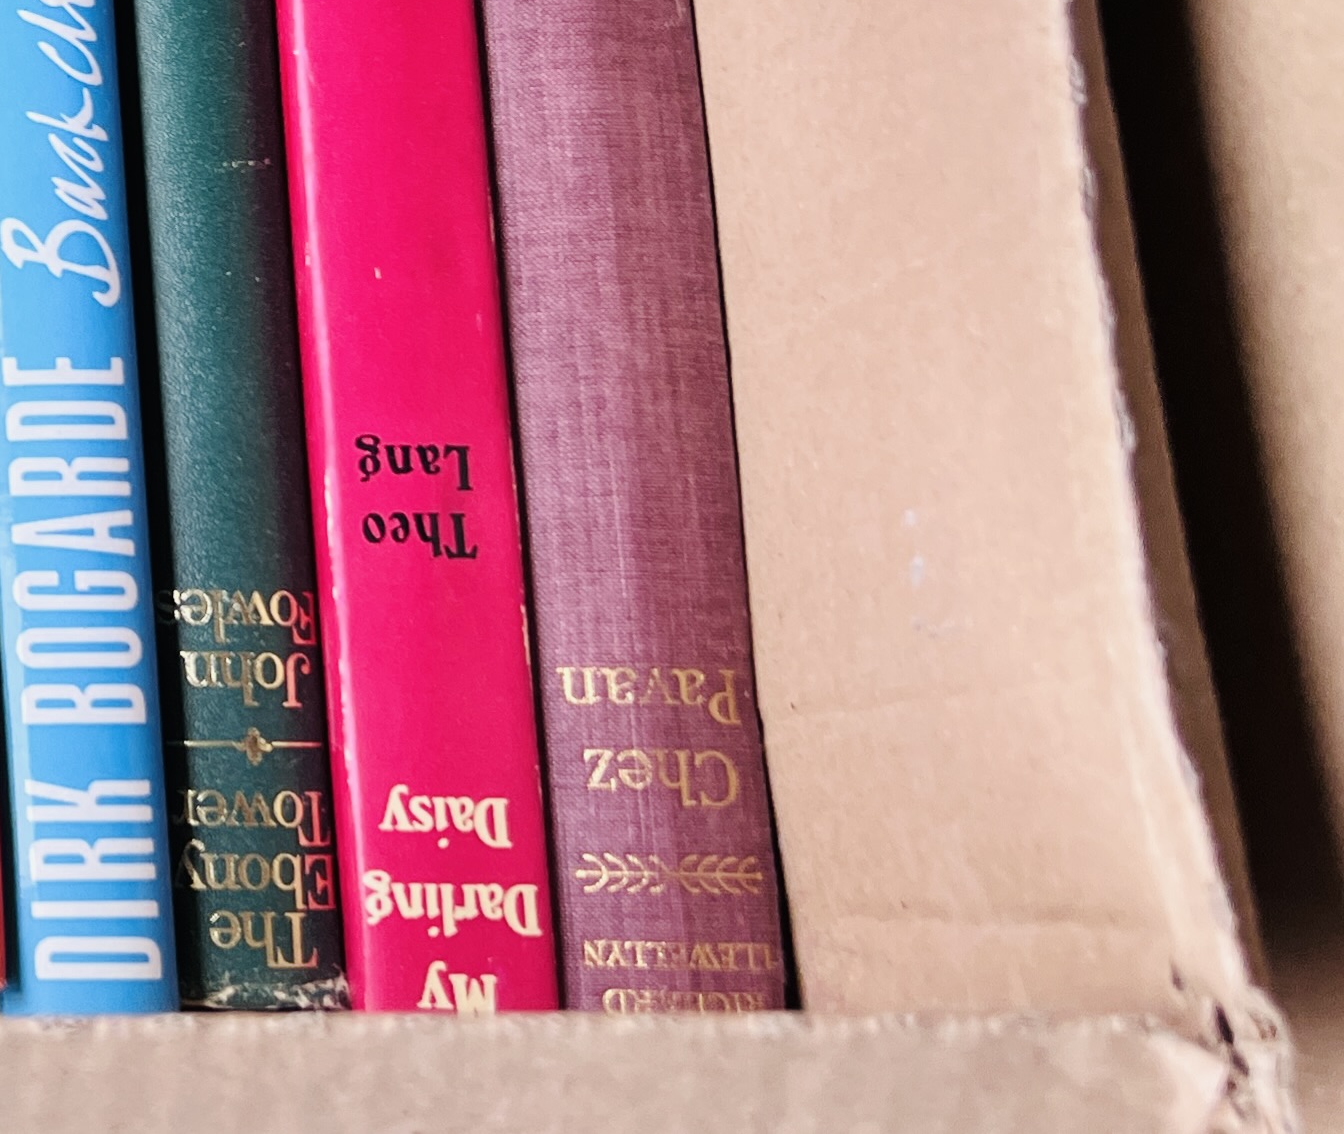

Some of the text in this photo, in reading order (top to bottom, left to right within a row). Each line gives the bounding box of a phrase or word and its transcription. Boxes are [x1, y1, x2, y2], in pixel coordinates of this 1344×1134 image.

[354, 433, 474, 492] Lang
[362, 511, 478, 560] Theo
[157, 588, 317, 646] Fowles
[2, 356, 163, 982] DIRK BOGARDE
[180, 650, 311, 709] John
[557, 666, 742, 726] Pavan
[583, 747, 740, 810] Chez
[174, 788, 331, 848] Tower
[378, 784, 513, 849] Daisy
[175, 838, 337, 912] Ebony
[361, 869, 544, 937] Darling
[208, 909, 319, 969] The
[583, 938, 781, 969] LLEWELLYN
[416, 959, 498, 1016] My
